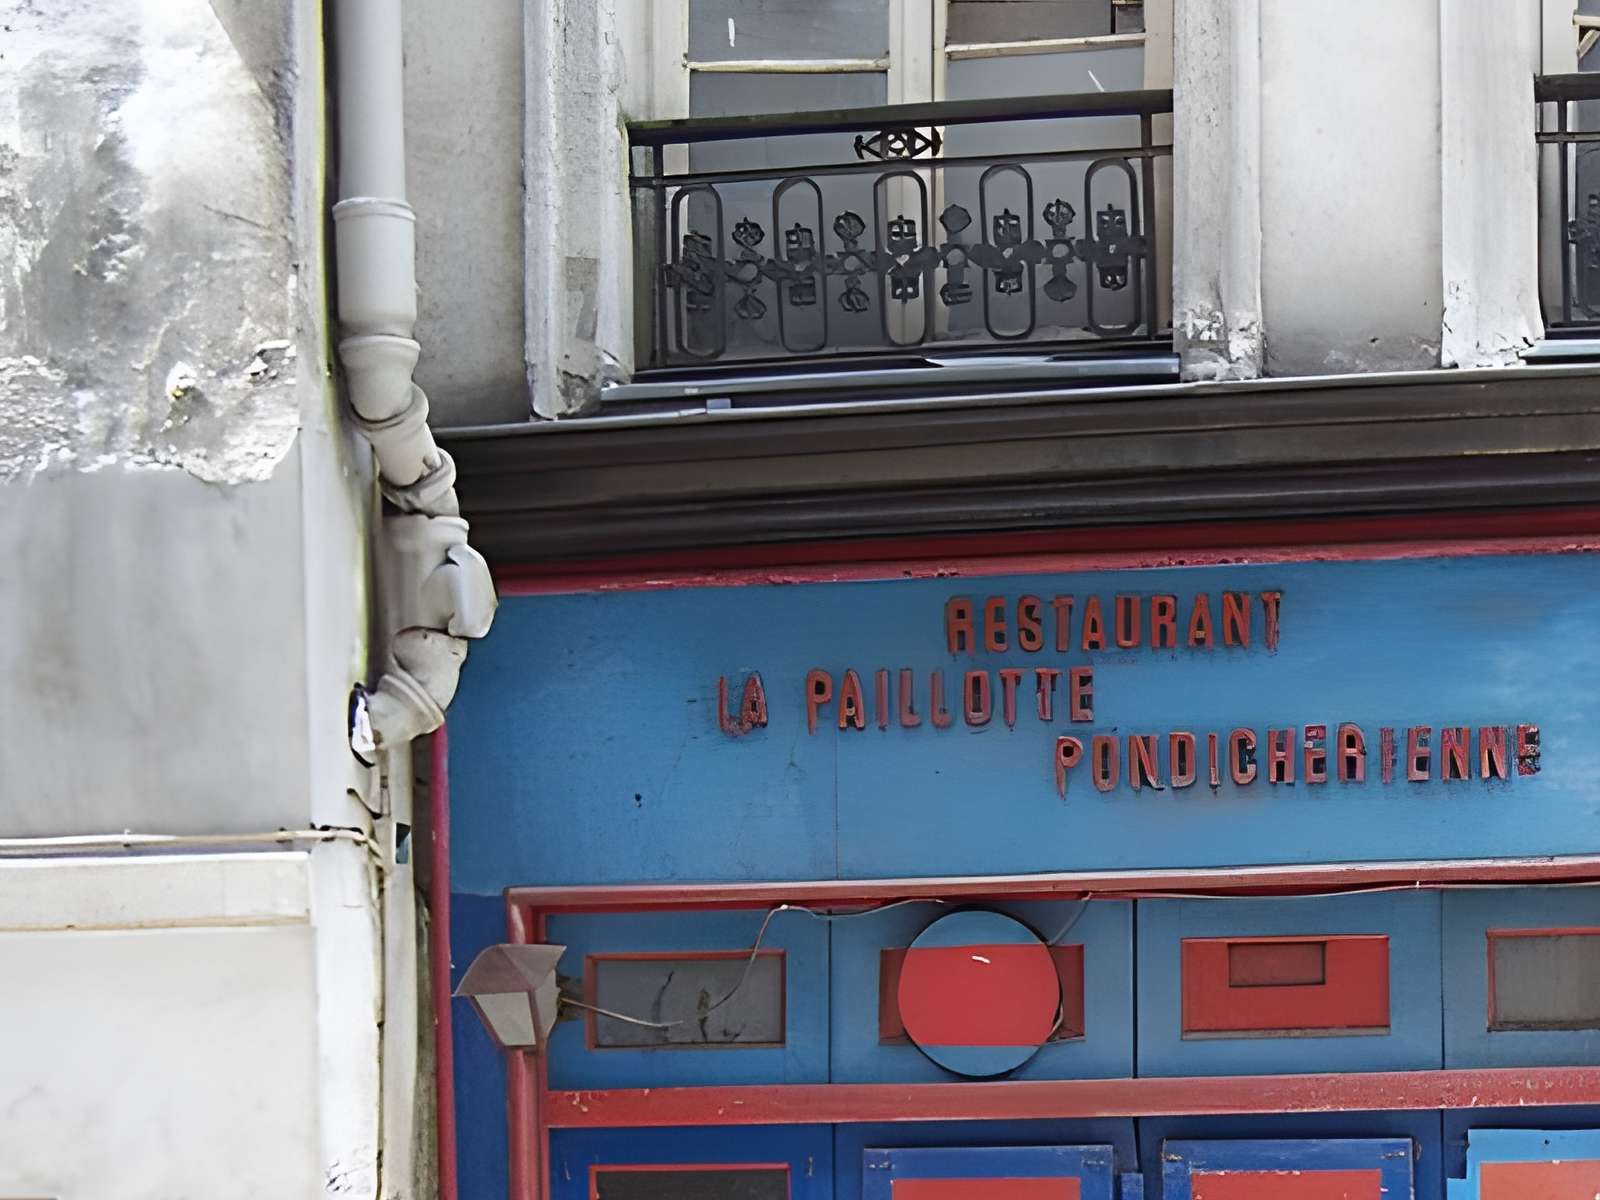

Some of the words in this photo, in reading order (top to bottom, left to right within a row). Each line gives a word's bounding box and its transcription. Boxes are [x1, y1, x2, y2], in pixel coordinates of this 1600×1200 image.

[945, 590, 1282, 656] RESTAURANT
[716, 669, 769, 736] LA
[805, 665, 1095, 736] PAILLOTTE
